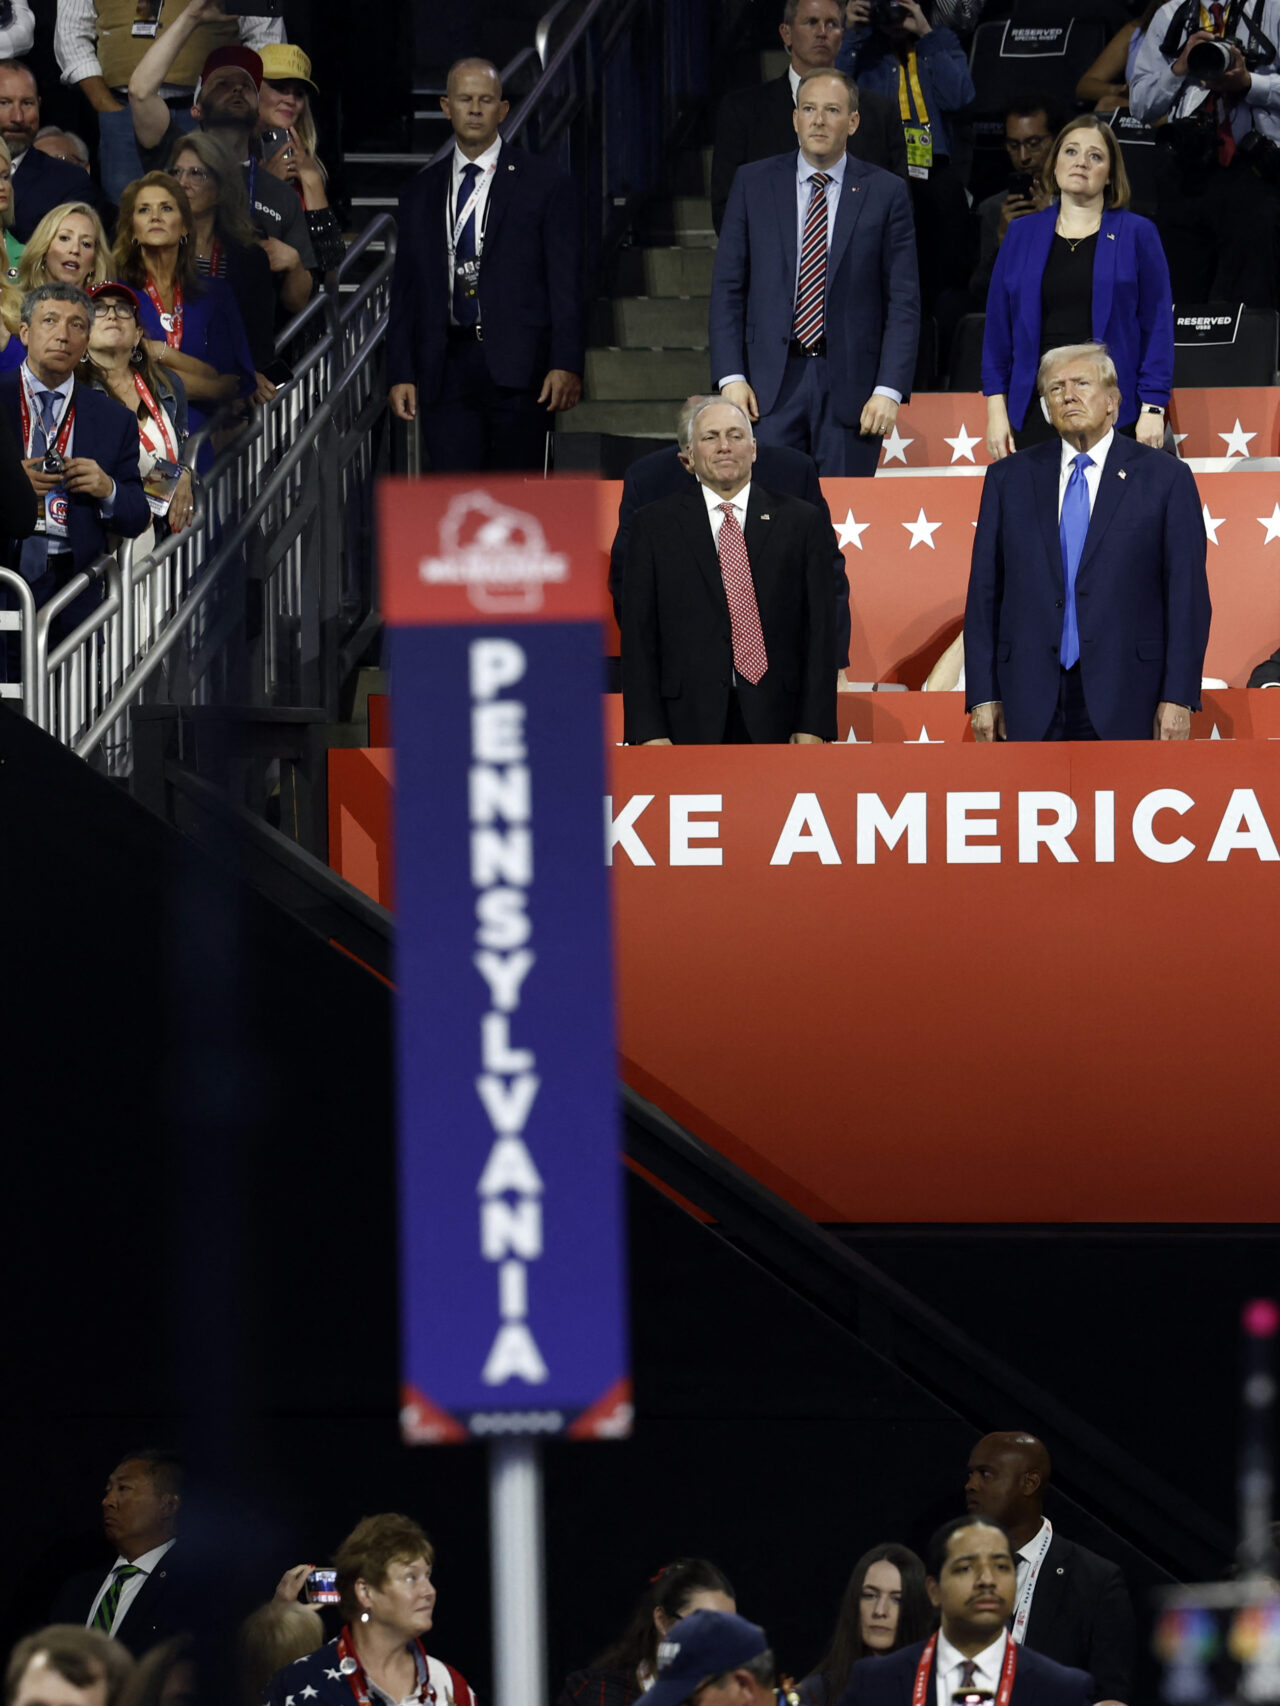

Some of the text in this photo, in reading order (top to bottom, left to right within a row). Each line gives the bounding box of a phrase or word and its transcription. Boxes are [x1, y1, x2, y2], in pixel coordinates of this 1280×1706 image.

[1011, 28, 1063, 37] RESERVED
[254, 201, 282, 222] Boop
[1177, 316, 1232, 326] RESERVED
[769, 788, 1280, 866] AMERICA
[468, 636, 549, 1386] PENNSYLVANIA
